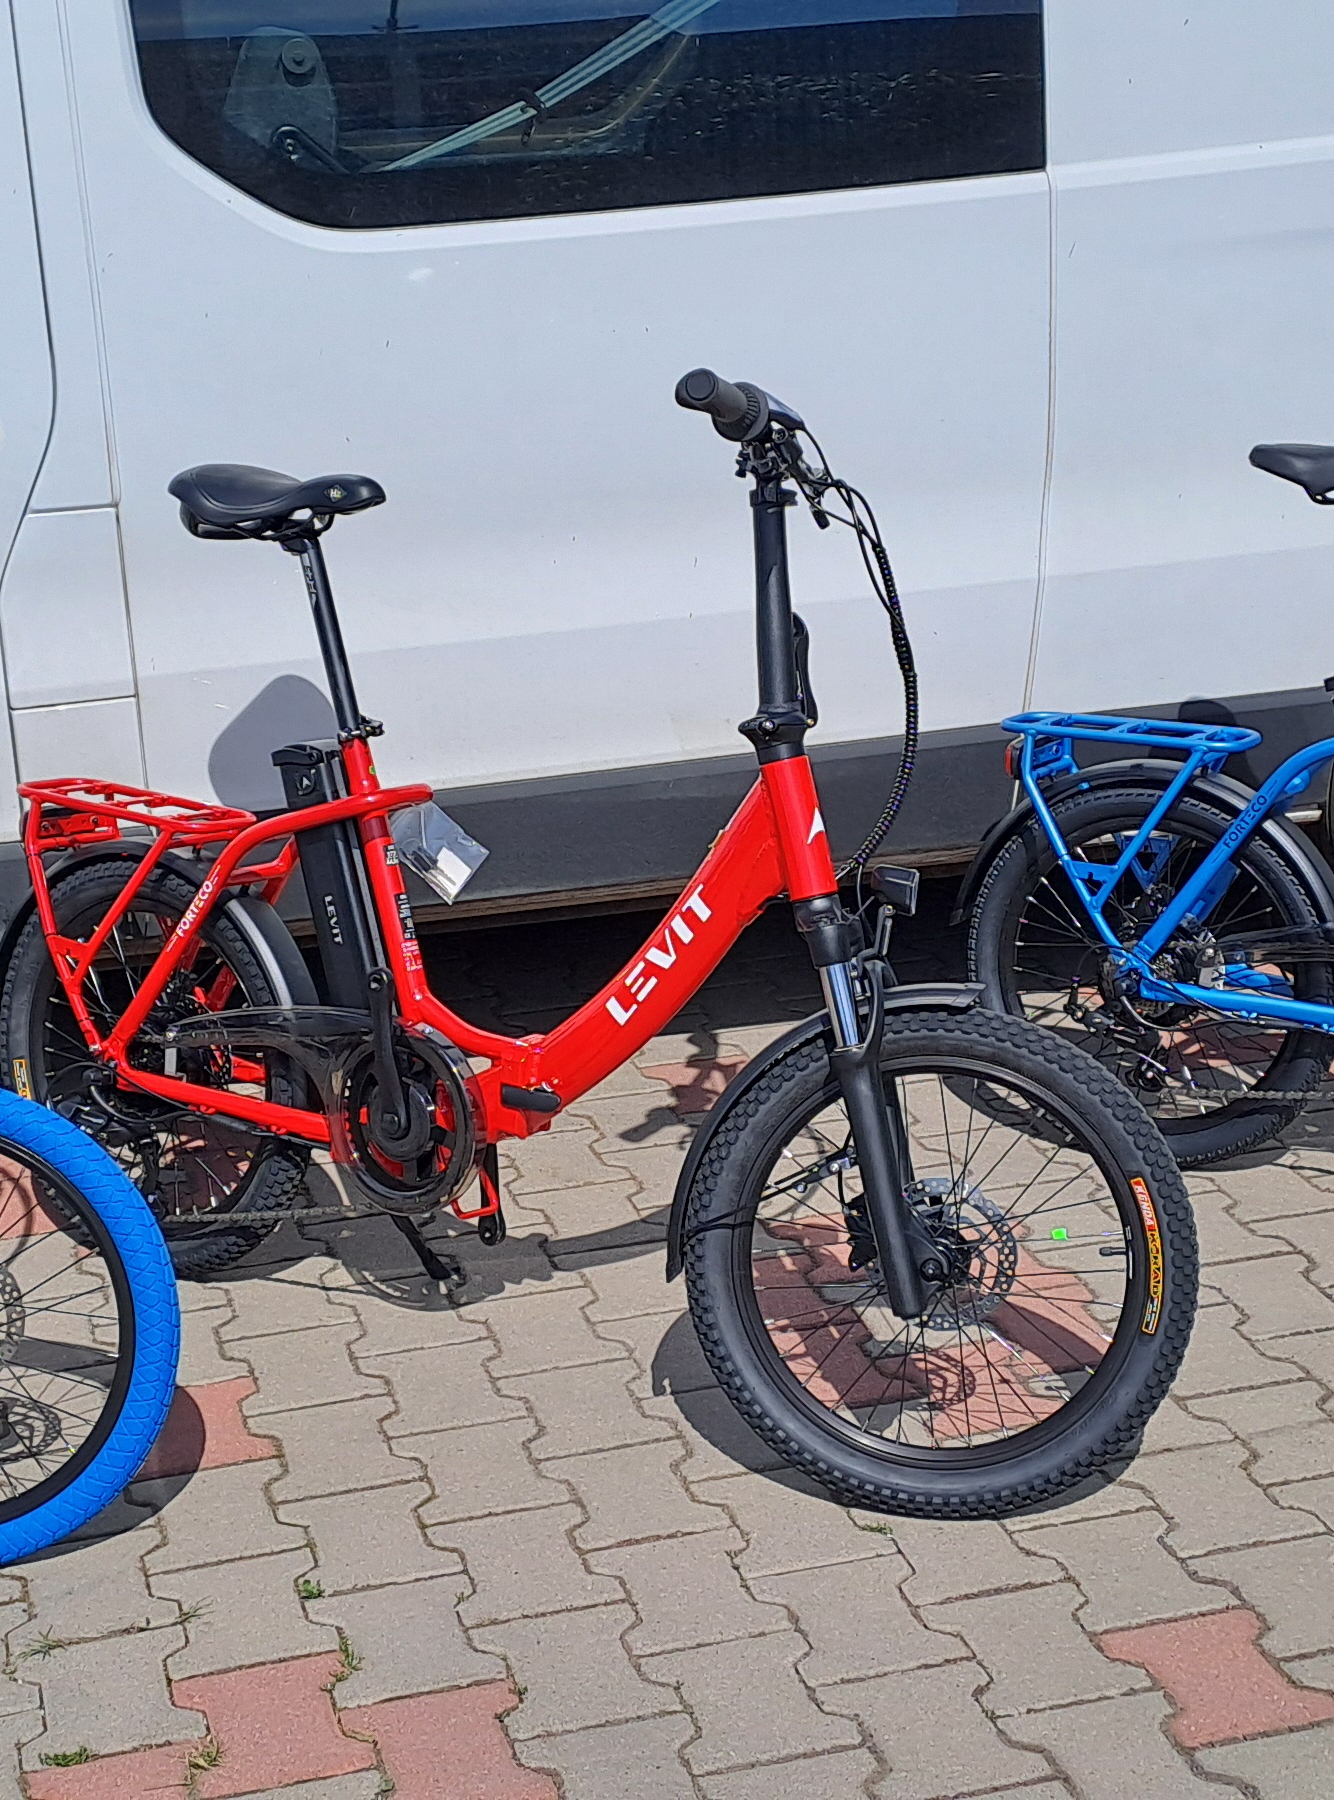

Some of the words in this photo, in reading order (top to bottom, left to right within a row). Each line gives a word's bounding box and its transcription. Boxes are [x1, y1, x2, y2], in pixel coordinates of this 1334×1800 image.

[1222, 794, 1268, 849] FORTECO
[175, 880, 213, 938] FORTECO
[323, 894, 344, 946] LEVIT
[604, 882, 713, 1027] LEVIT
[1133, 1185, 1155, 1227] KENDA
